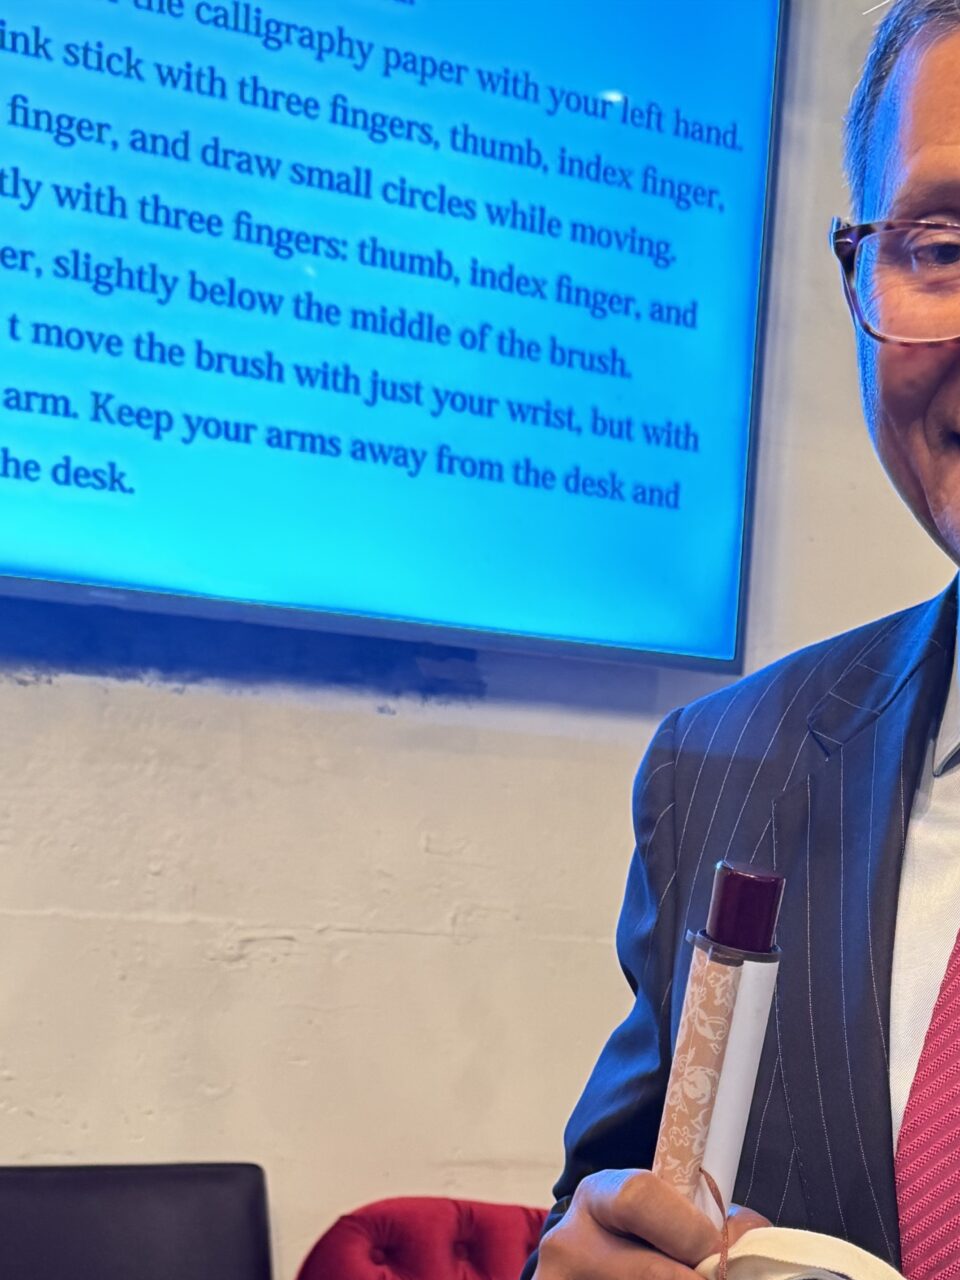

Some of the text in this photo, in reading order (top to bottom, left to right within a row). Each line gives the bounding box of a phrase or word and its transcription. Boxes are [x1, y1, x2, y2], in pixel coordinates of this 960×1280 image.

[0, 19, 724, 212] ink stick with three fingers, thumb, index finger,
[195, 0, 374, 71] calligraphy
[383, 47, 469, 86] paper
[476, 67, 539, 104] with
[546, 84, 614, 119] your
[621, 96, 665, 134] left
[673, 108, 743, 151] hand.
[8, 94, 676, 269] finger, and draw small circles while moving.
[51, 182, 128, 219] with
[138, 194, 223, 237] three
[234, 210, 348, 261] fingers:
[358, 237, 460, 285] thumb,
[469, 257, 547, 300] index
[555, 274, 641, 320] finger,
[649, 300, 698, 329] and
[53, 249, 179, 305] slightly
[188, 270, 284, 316] below
[292, 291, 341, 326] the
[350, 306, 452, 346] middle
[458, 322, 492, 352] of
[497, 327, 541, 362] the
[549, 336, 632, 379] brush.
[3, 388, 680, 510] arm. Keep your arms away from the desk and
[8, 314, 699, 452] t move the brush with just your wrist, but with
[51, 455, 135, 494] desk.
